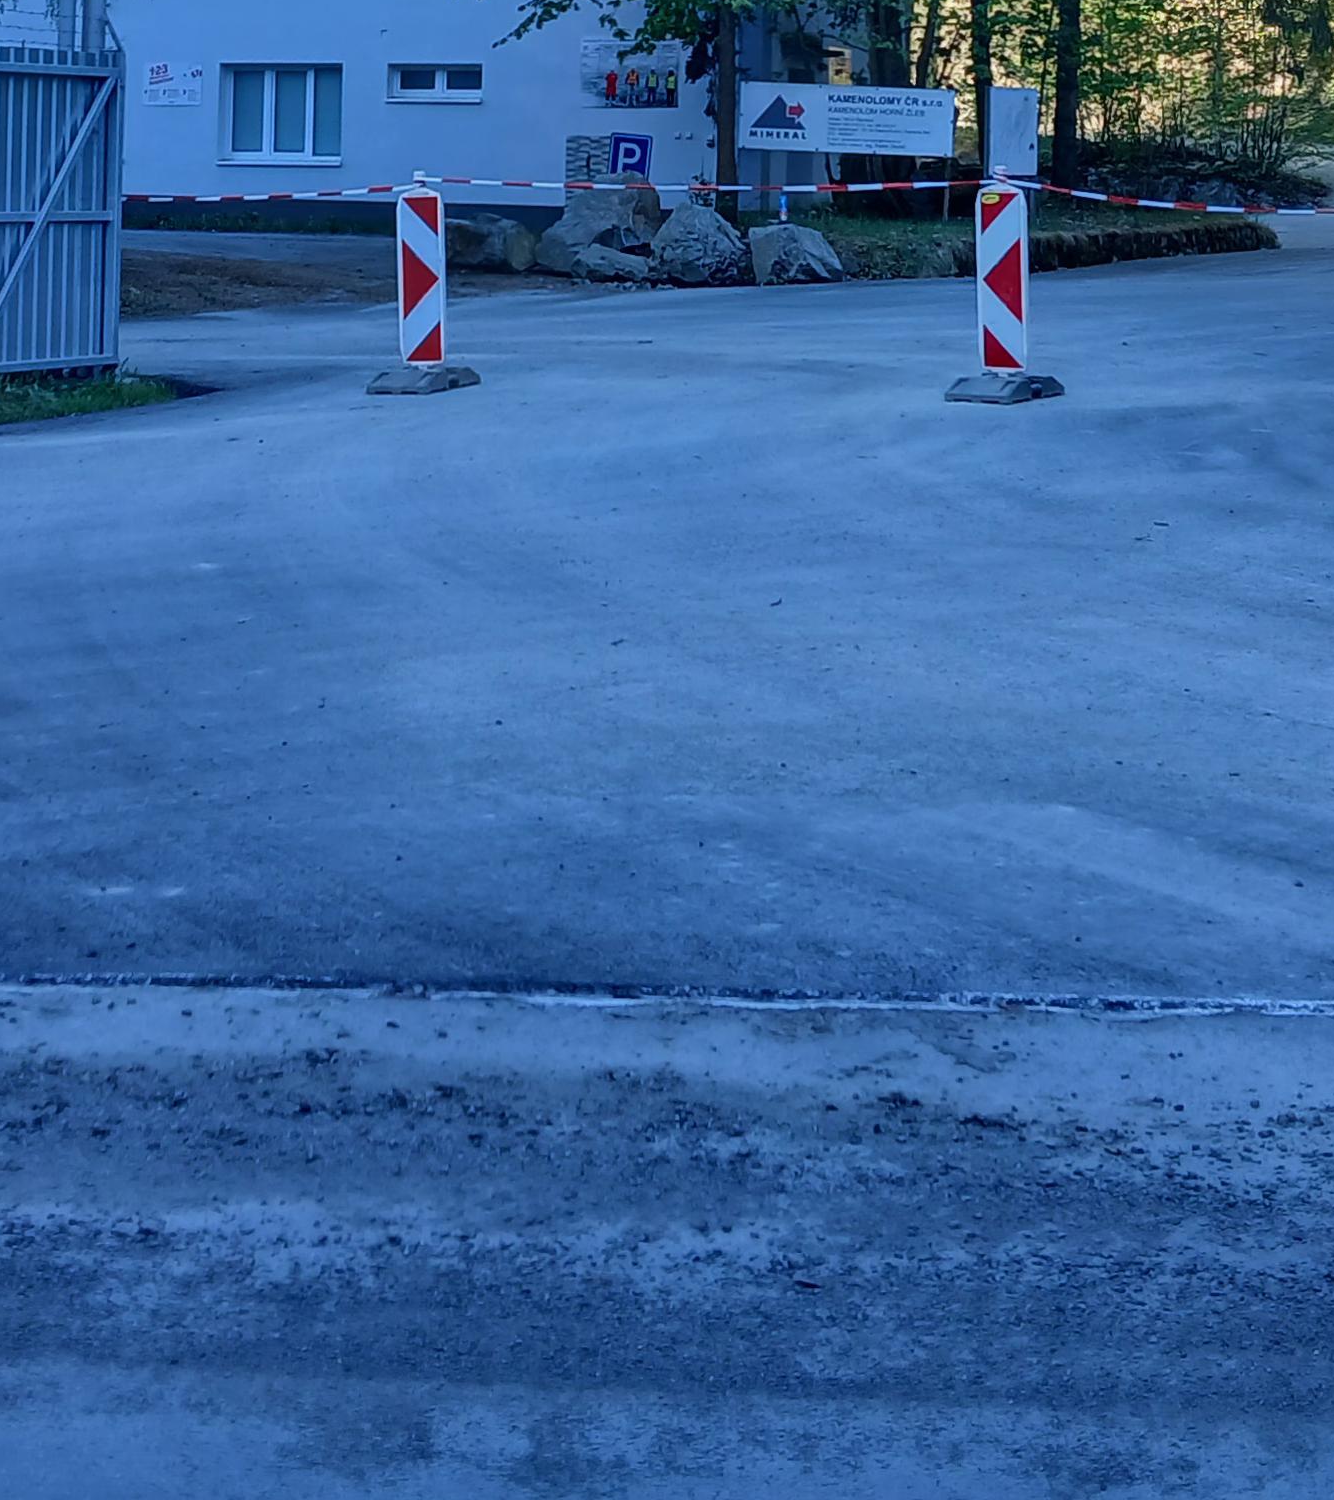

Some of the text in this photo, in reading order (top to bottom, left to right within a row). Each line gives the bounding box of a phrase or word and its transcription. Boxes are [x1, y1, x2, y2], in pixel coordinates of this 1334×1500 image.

[827, 93, 903, 106] KAMENOLOMY
[904, 94, 919, 107] ČR
[749, 130, 807, 140] MINERAL
[617, 142, 641, 174] P
